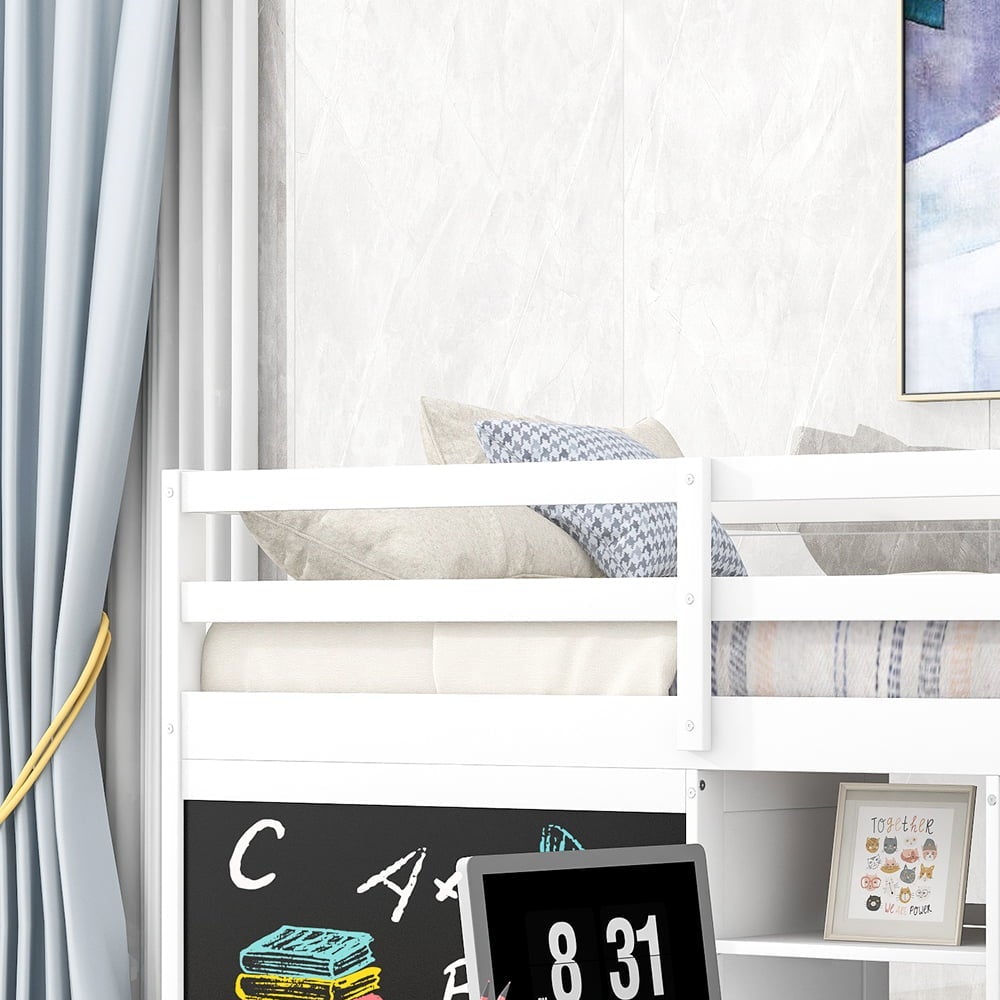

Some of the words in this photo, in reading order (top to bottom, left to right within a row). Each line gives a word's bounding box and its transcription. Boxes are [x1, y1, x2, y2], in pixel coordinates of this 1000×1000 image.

[229, 818, 286, 891] C
[356, 847, 427, 923] A
[606, 915, 664, 1000] 31
